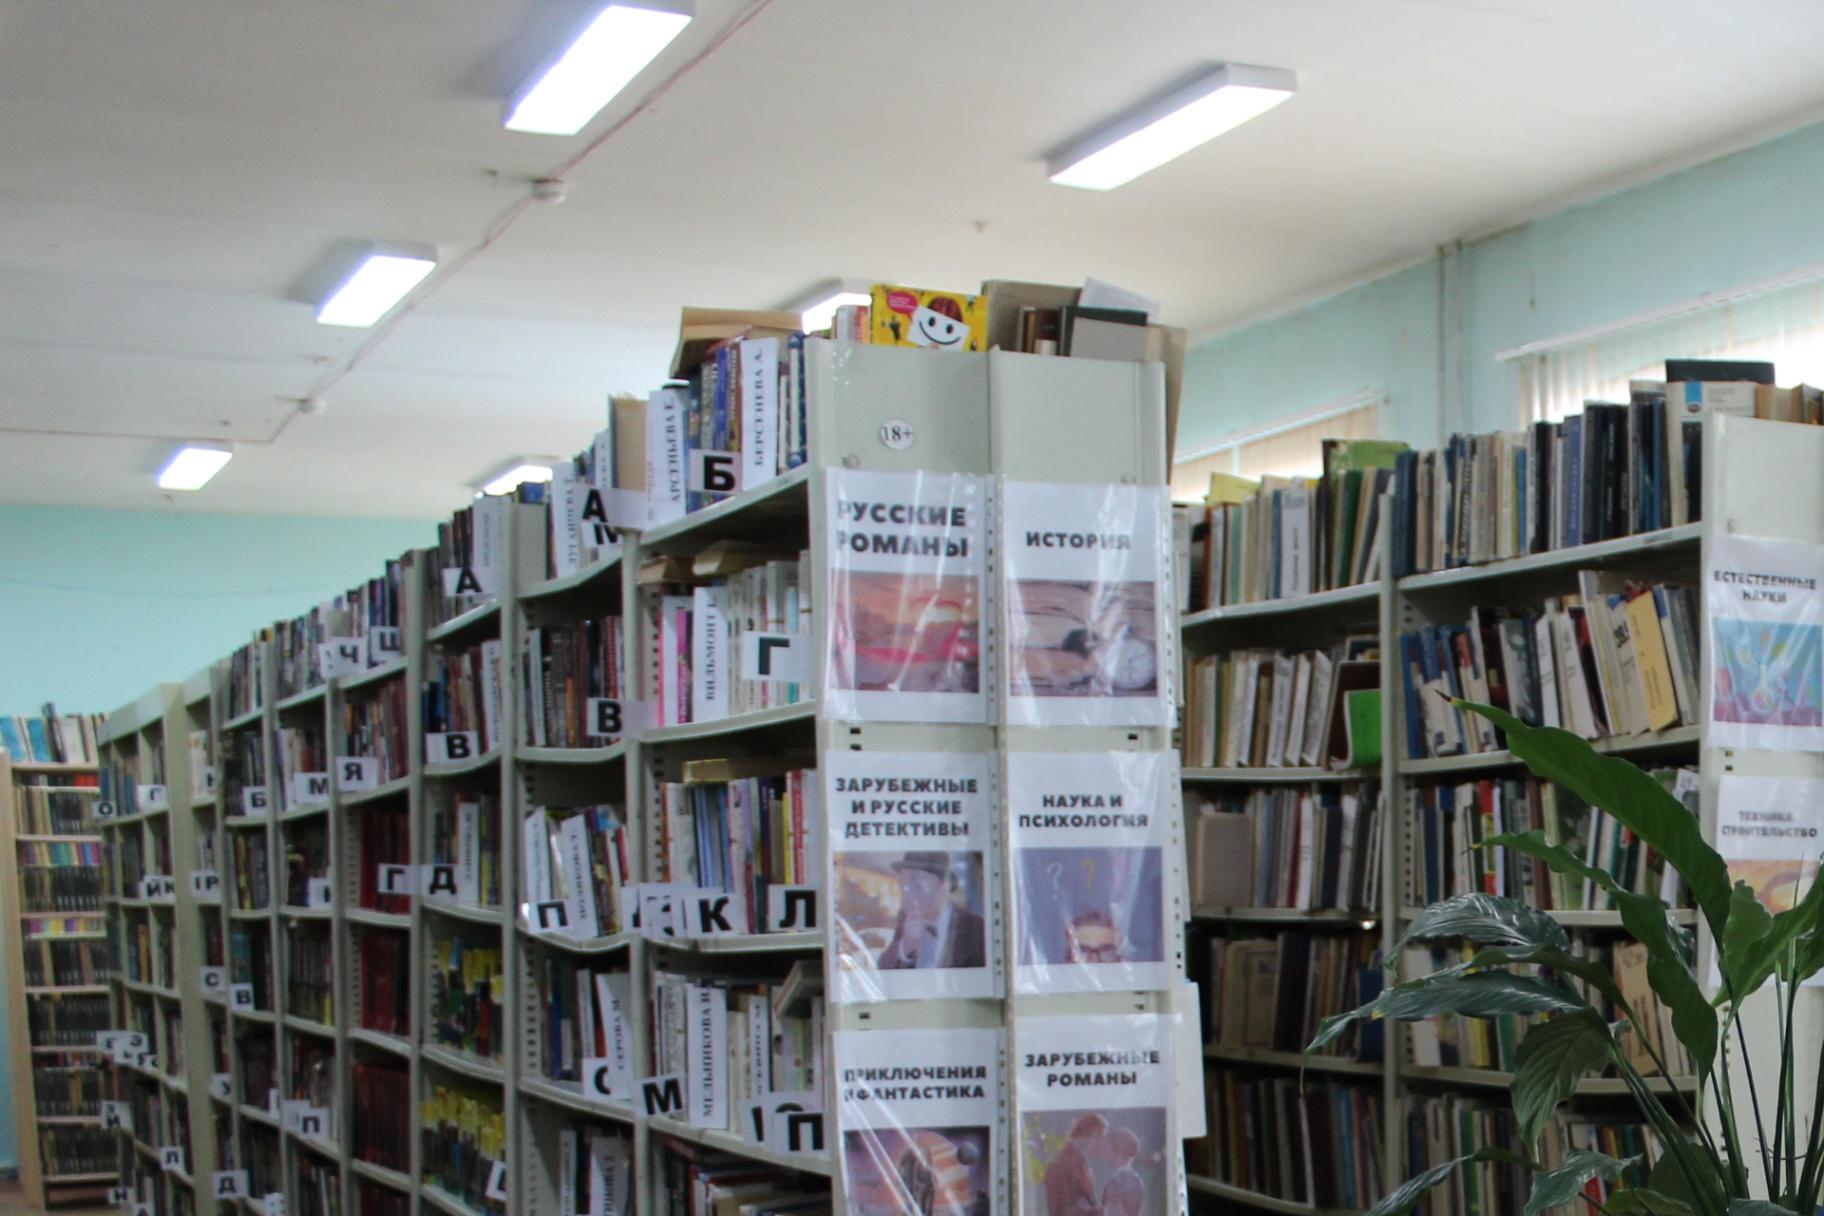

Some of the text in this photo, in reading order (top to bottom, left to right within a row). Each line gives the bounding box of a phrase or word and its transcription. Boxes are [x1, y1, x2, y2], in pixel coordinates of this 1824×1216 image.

[881, 425, 914, 441] 18+
[704, 455, 735, 491] Б
[582, 488, 608, 522] А
[838, 501, 966, 527] РУССКИЕ
[838, 530, 968, 558] РОМАНЫ
[1026, 531, 1131, 551] ИСТОРИЯ
[456, 567, 483, 594] А
[1714, 570, 1817, 591] ЕСТЕСТВЕННЫЕ
[1743, 589, 1787, 604] НАУКИ
[758, 636, 790, 675] Г
[599, 699, 623, 733] В
[446, 735, 471, 760] В
[345, 762, 363, 781] Я
[836, 777, 978, 794] ЗАРУБЕЖНЫЕ
[251, 793, 267, 808] Б
[852, 801, 962, 815] И РУССКИЕ
[1042, 794, 1123, 808] НАУКА И
[845, 821, 970, 838] ДЕТЕКТИВЫ
[1019, 813, 1149, 829] ПСИХОЛОГИЯ
[387, 868, 405, 890] Г
[429, 867, 457, 894] Д
[537, 901, 568, 928] П
[700, 896, 733, 932] К
[779, 889, 816, 928] Л
[205, 972, 219, 986] С
[702, 1007, 714, 1118] МЕЛЬНИКОВА
[1024, 1049, 1161, 1068] ЗАРУБЕЖНЫЕ
[845, 1065, 987, 1082] ПРИКЛЮЧЕНИЯ
[1046, 1071, 1138, 1089] РОМАНЫ
[643, 1077, 683, 1115] М
[857, 1085, 985, 1101] ФАНТАСТИКА
[303, 1116, 321, 1133] П
[788, 1112, 824, 1151] П
[219, 1176, 236, 1195] Д
